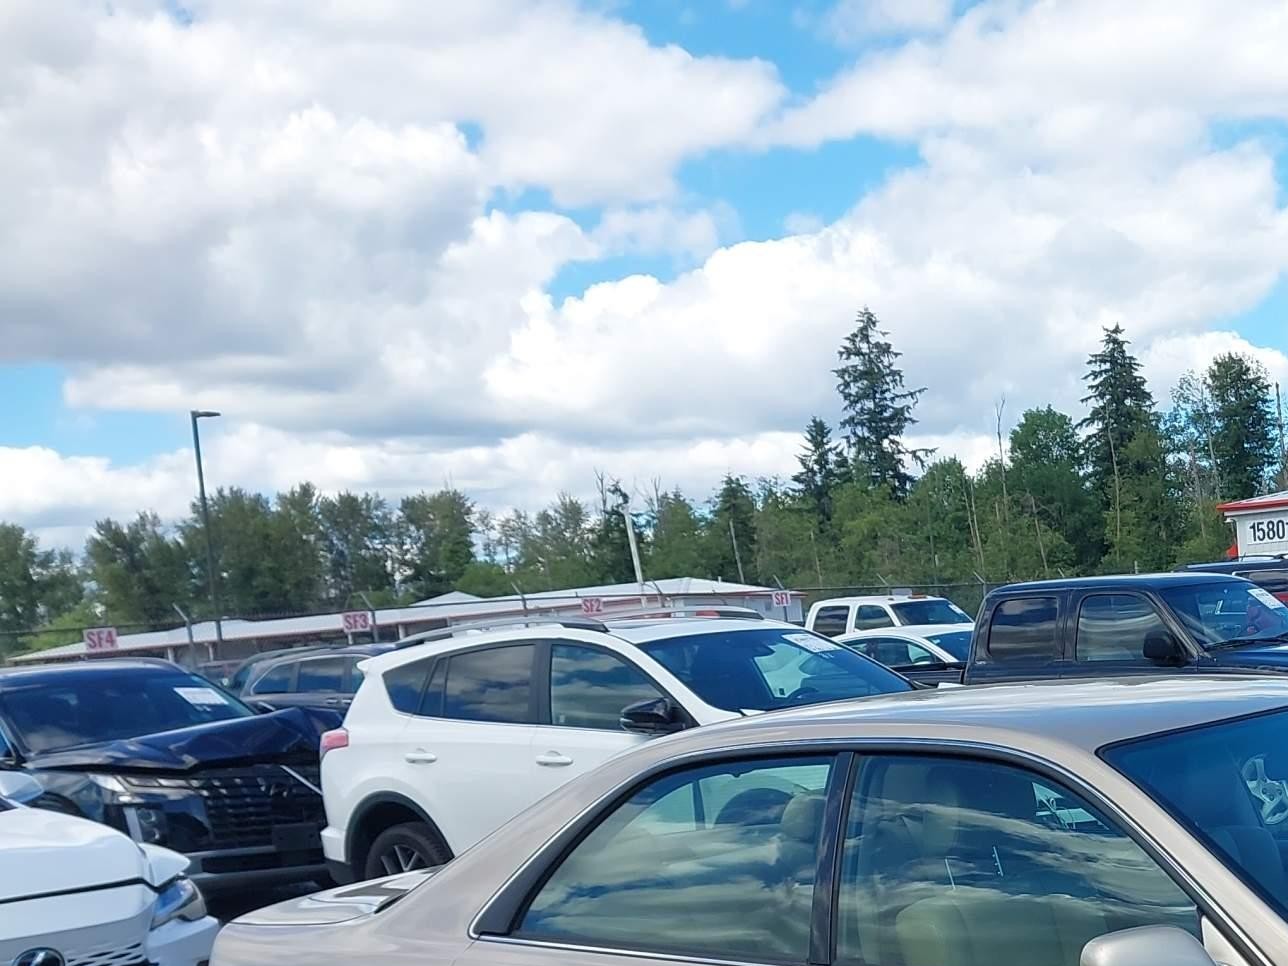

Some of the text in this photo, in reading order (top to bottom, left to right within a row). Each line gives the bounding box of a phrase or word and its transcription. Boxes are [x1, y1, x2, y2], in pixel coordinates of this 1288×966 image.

[583, 598, 602, 613] SF2
[345, 614, 369, 630] SF3
[86, 630, 115, 649] SF4
